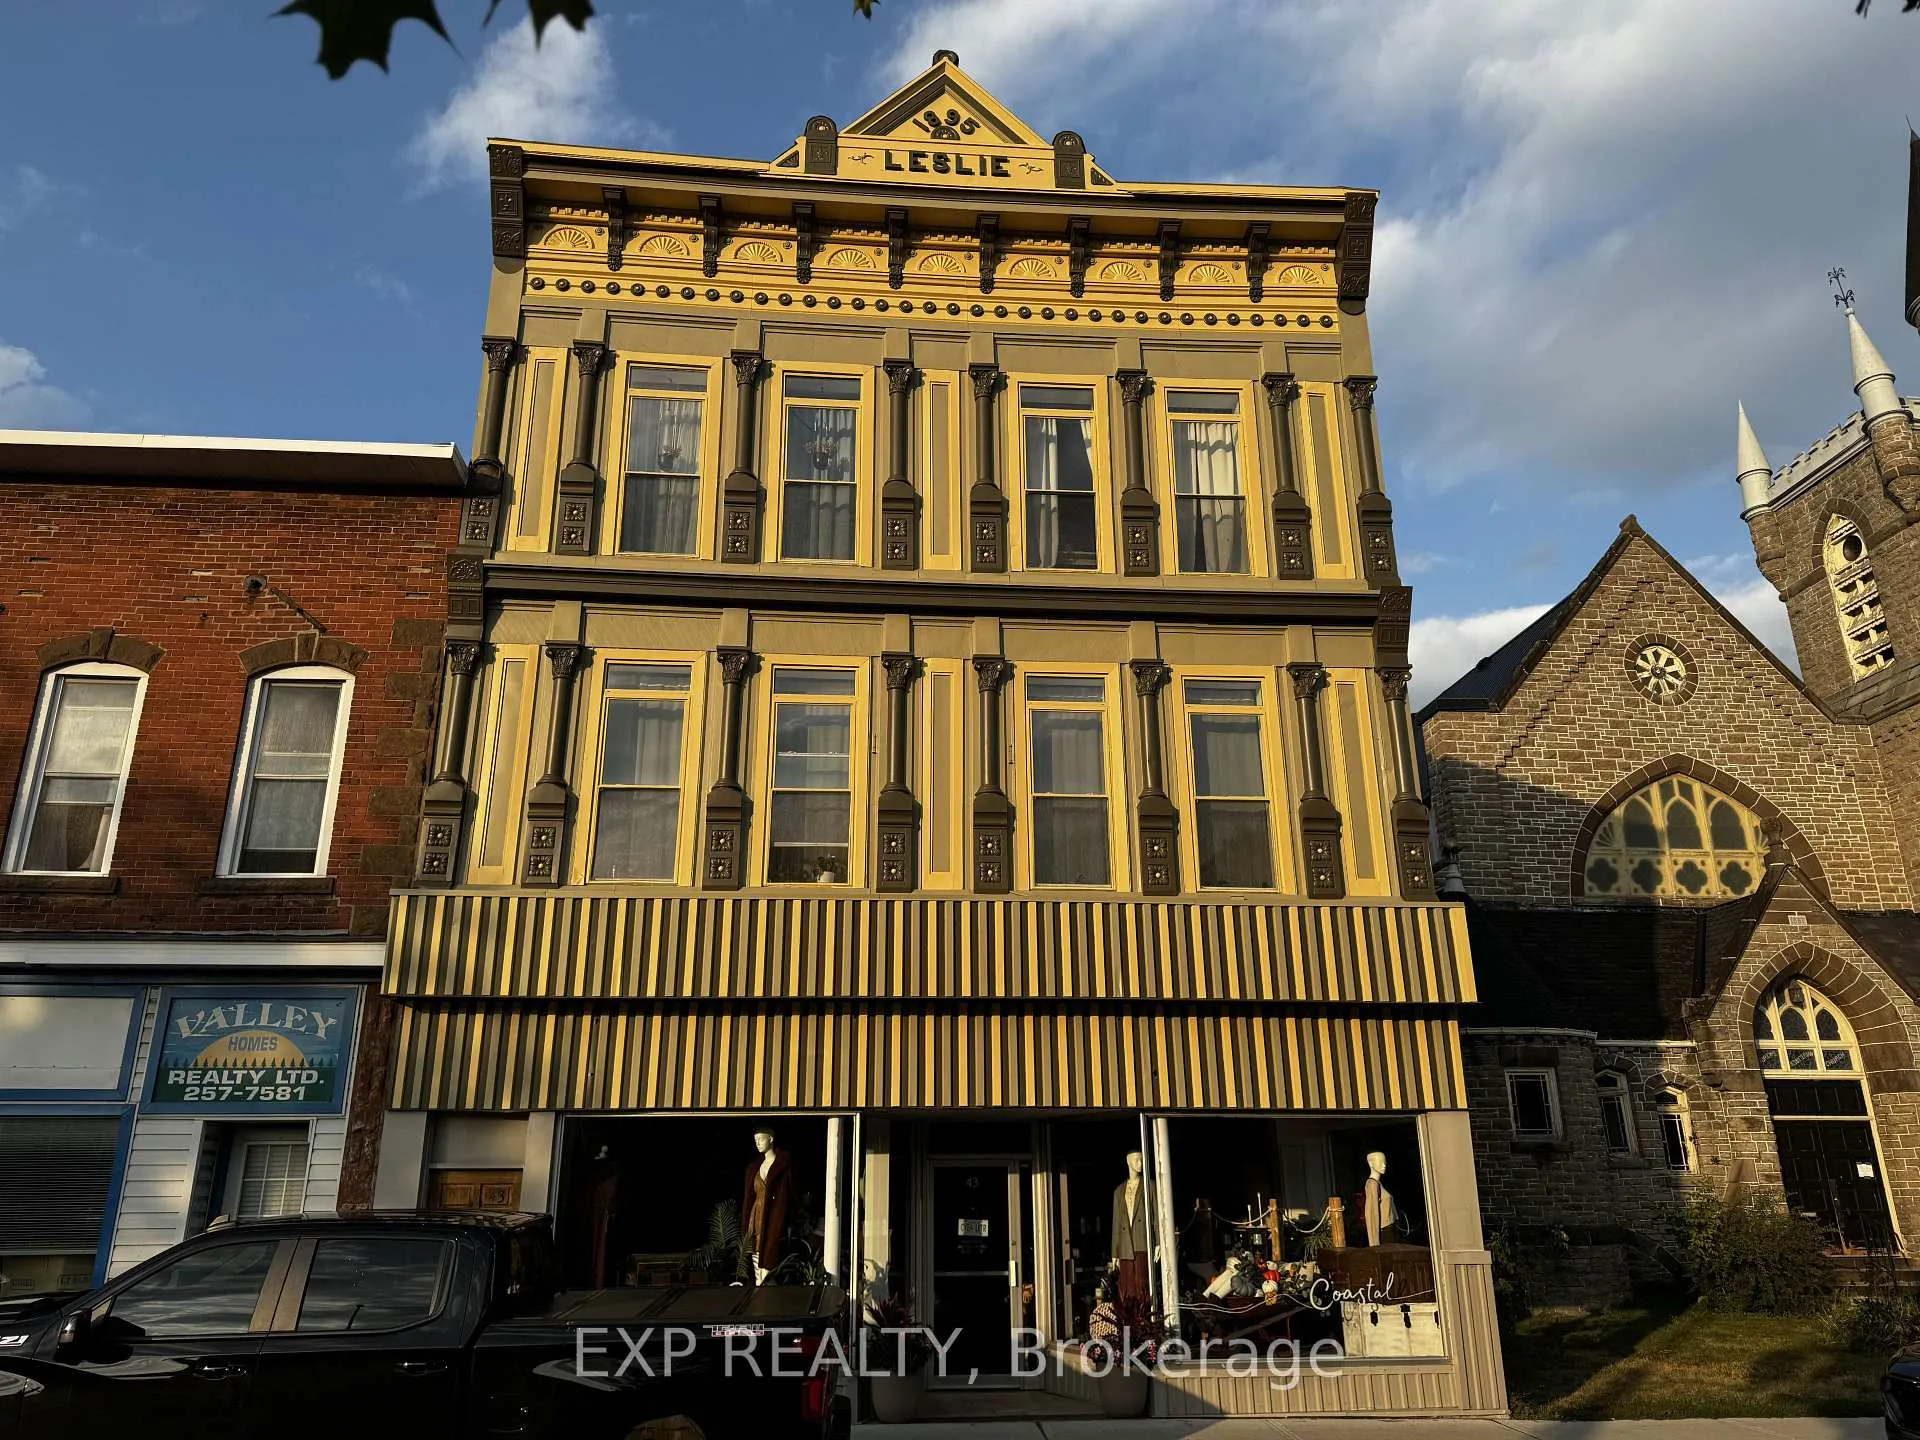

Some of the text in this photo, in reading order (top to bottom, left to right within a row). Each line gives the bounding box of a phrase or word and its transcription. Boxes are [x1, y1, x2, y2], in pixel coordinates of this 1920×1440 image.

[912, 109, 981, 135] 1895
[885, 149, 1011, 177] LESLIE
[175, 1003, 338, 1040] VALLEY
[228, 1036, 279, 1051] HOMES
[168, 1070, 325, 1085] REALTY LTD.
[184, 1086, 306, 1101] 257-7581
[1310, 1272, 1397, 1310] Coastal
